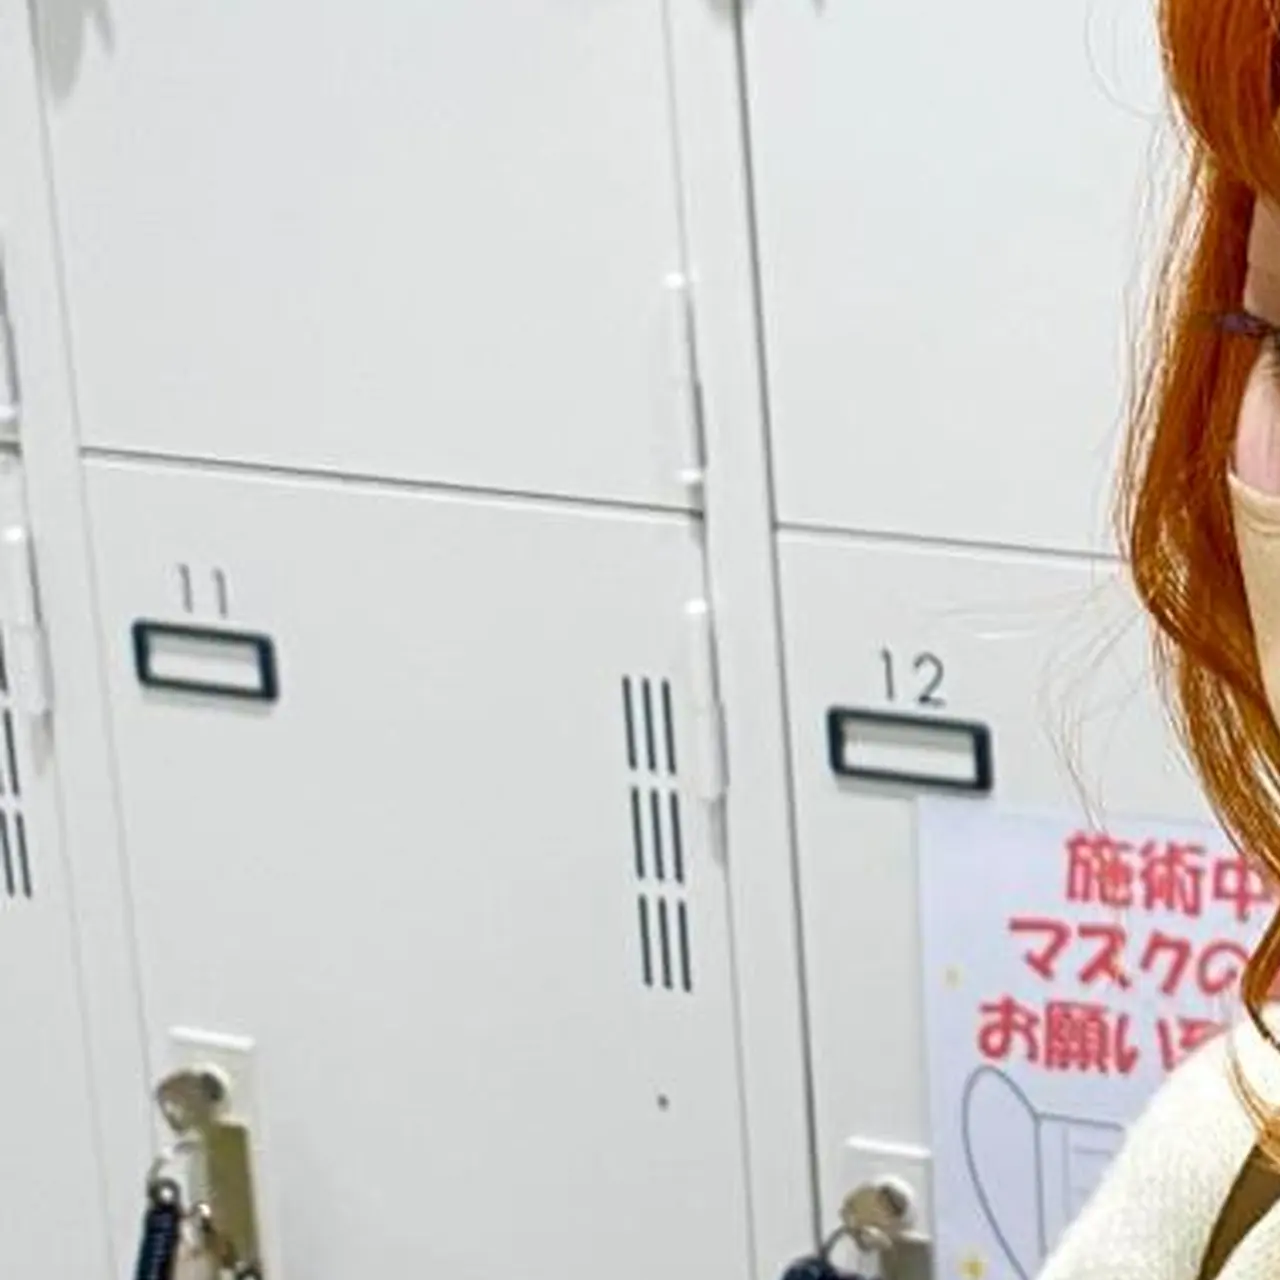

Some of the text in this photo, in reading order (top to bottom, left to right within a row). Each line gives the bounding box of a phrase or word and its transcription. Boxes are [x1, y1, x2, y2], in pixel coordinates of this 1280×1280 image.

[175, 563, 228, 618] 11
[881, 649, 946, 707] 12
[1066, 830, 1272, 920] 施術中
